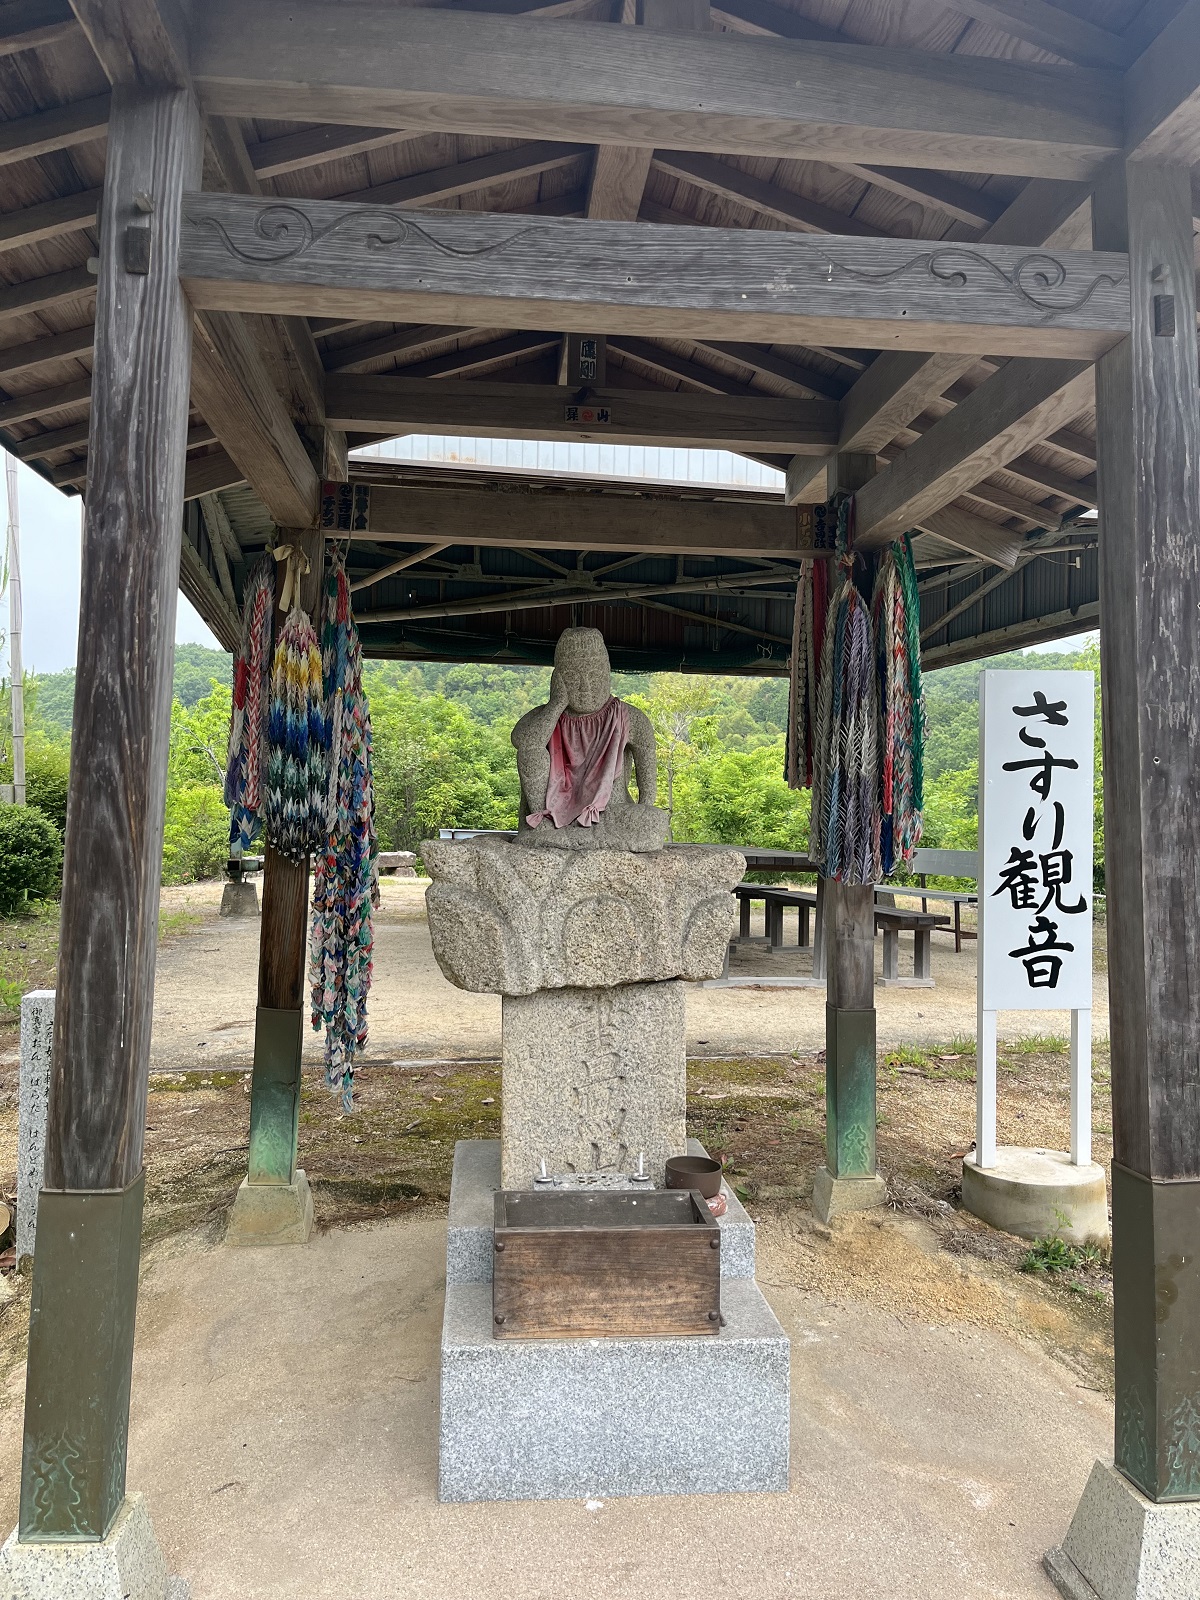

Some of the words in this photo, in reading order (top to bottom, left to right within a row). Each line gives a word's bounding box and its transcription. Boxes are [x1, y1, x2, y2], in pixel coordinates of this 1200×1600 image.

[990, 691, 1087, 989] さすり観音
